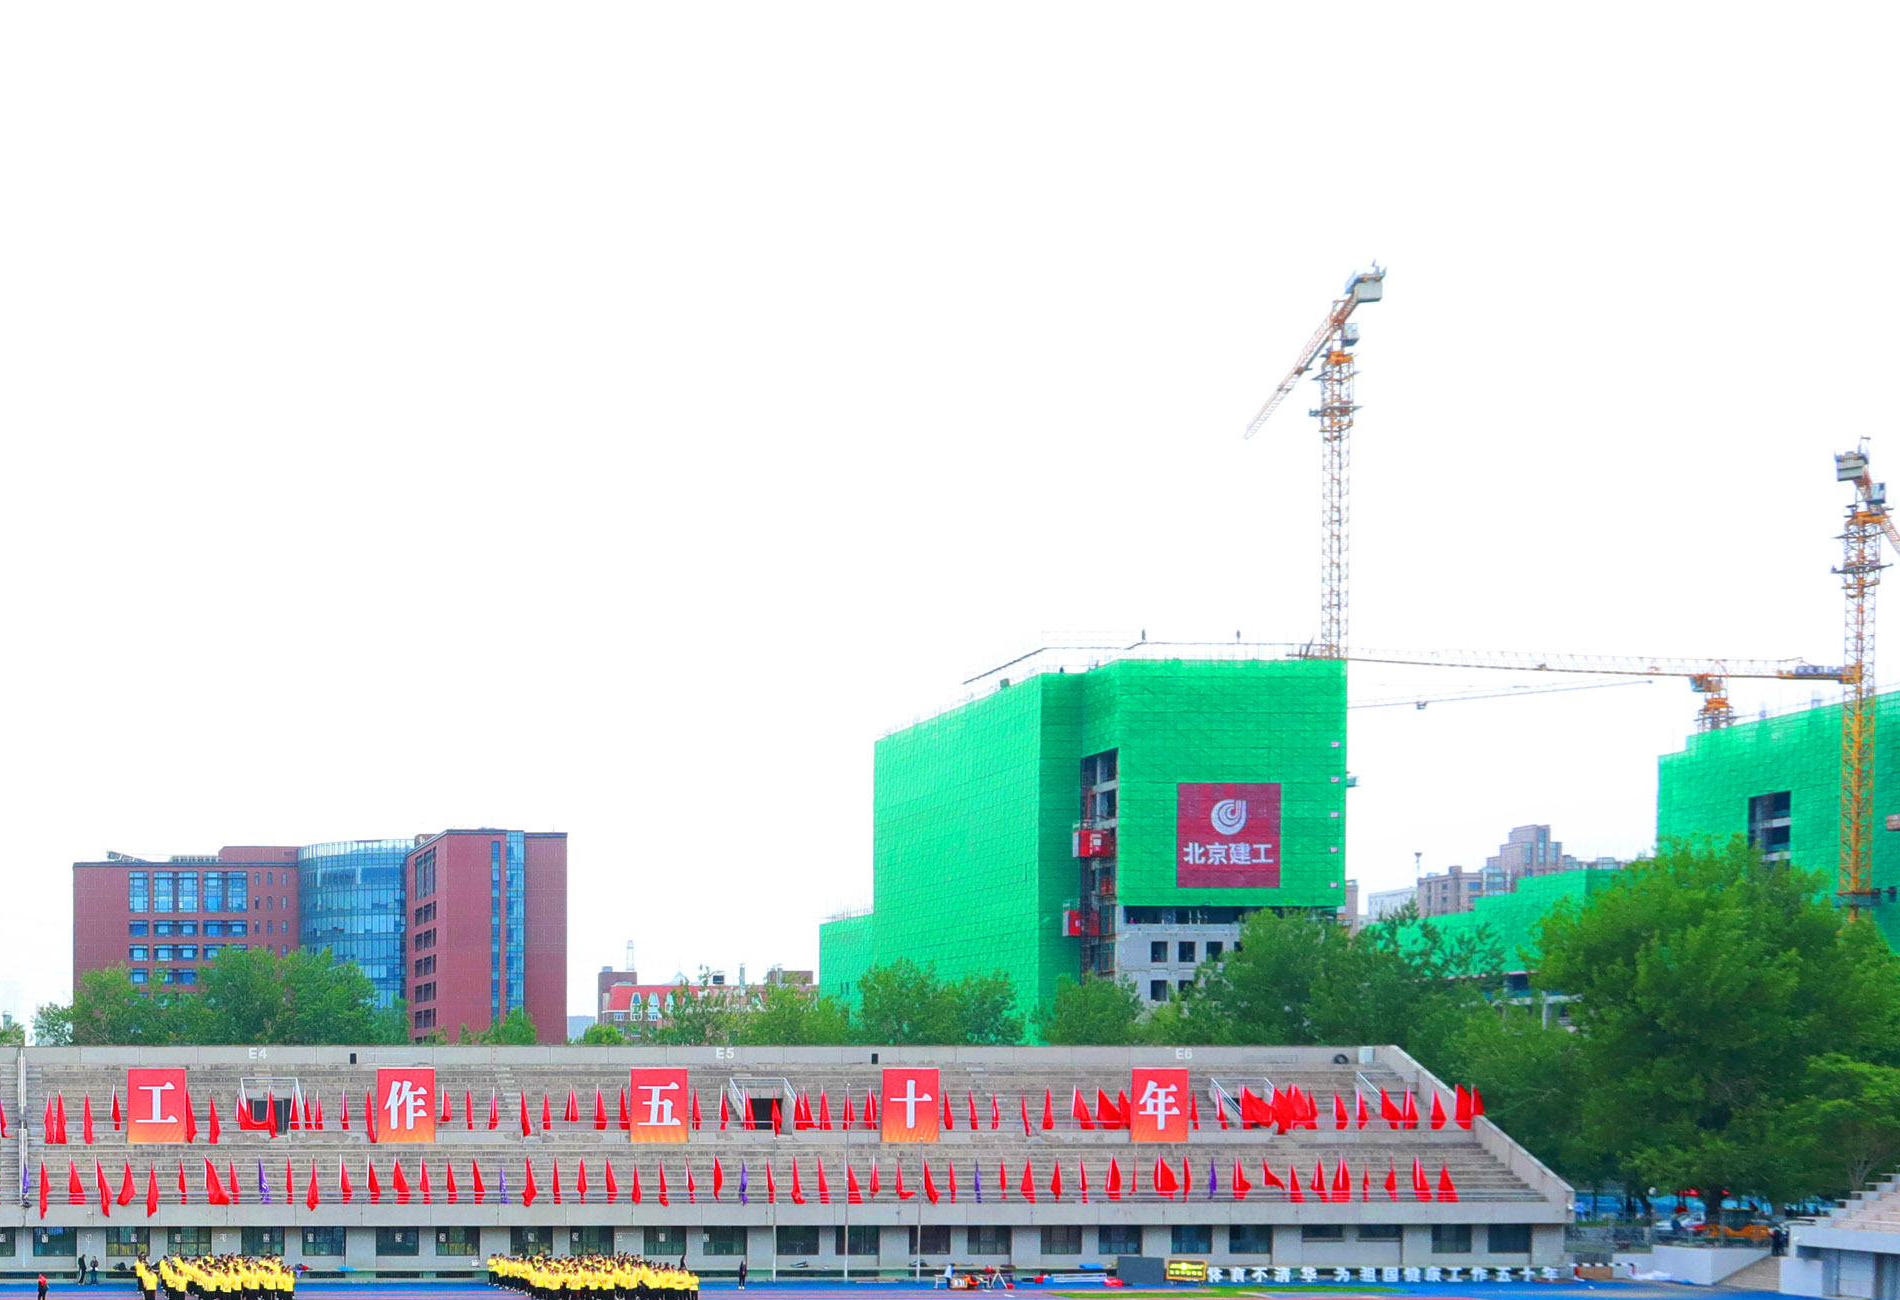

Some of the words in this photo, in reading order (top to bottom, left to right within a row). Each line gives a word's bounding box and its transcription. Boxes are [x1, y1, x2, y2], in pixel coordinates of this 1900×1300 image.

[1183, 842, 1273, 865] 北京建工
[249, 1047, 267, 1059] E4
[716, 1047, 734, 1059] E5
[1175, 1048, 1193, 1059] E6
[135, 1082, 178, 1123] 工
[384, 1081, 427, 1130] 作
[637, 1082, 681, 1126] 五
[890, 1080, 932, 1128] 十
[1139, 1081, 1180, 1130] 年
